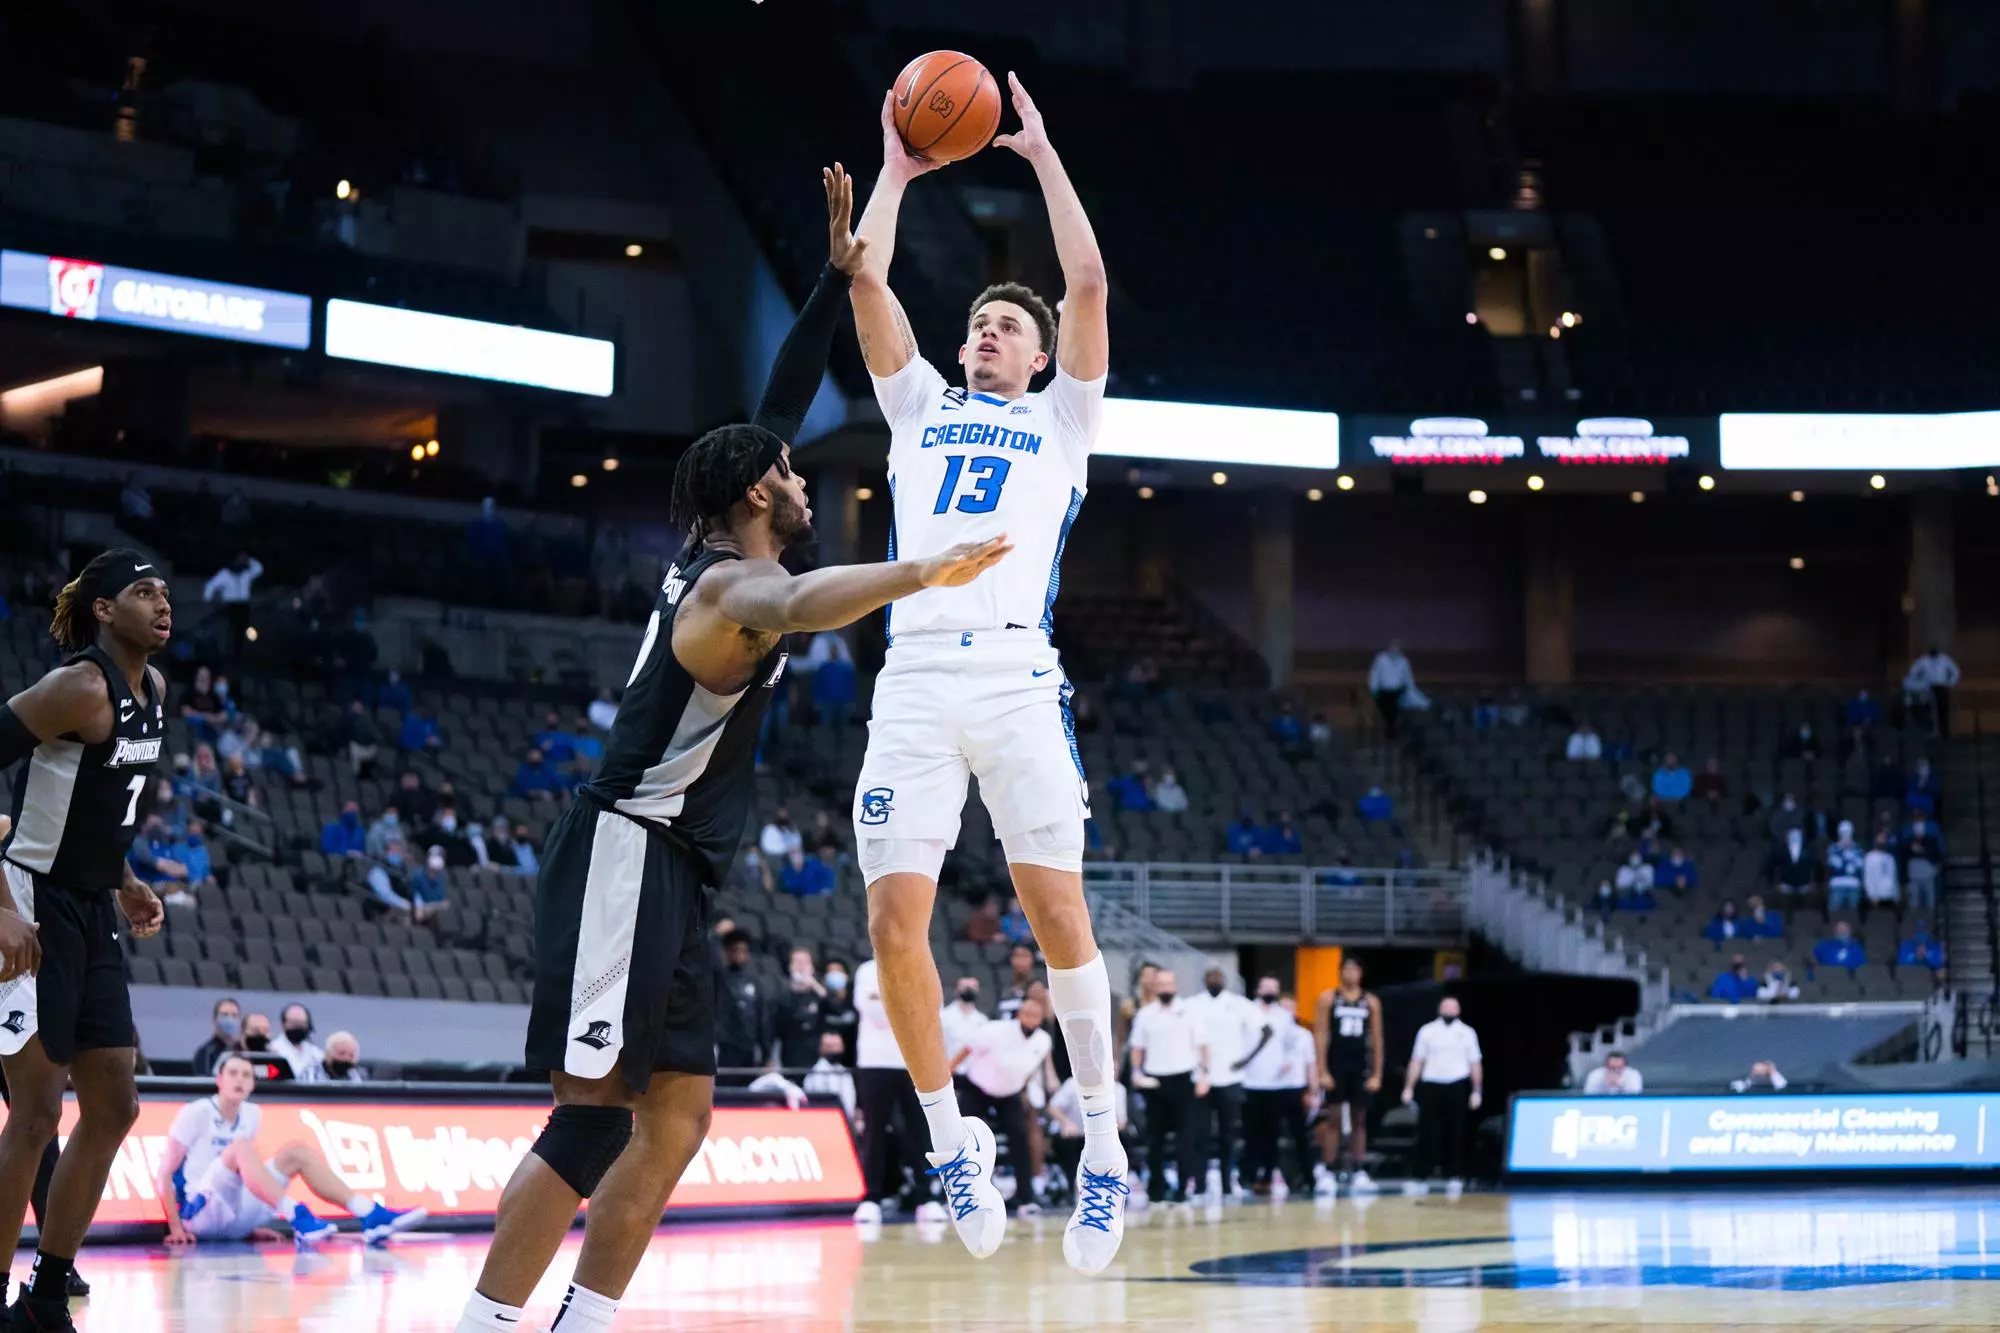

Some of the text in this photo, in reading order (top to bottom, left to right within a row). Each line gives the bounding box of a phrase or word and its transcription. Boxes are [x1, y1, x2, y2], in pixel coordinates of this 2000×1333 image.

[112, 280, 265, 331] GATORADE
[921, 423, 1043, 455] CREIGHTON
[933, 455, 1012, 515] 13
[121, 774, 147, 826] 1
[1708, 1108, 1939, 1132] Commercial Cleaning
[1689, 1131, 1956, 1157] and Facility Maintenance
